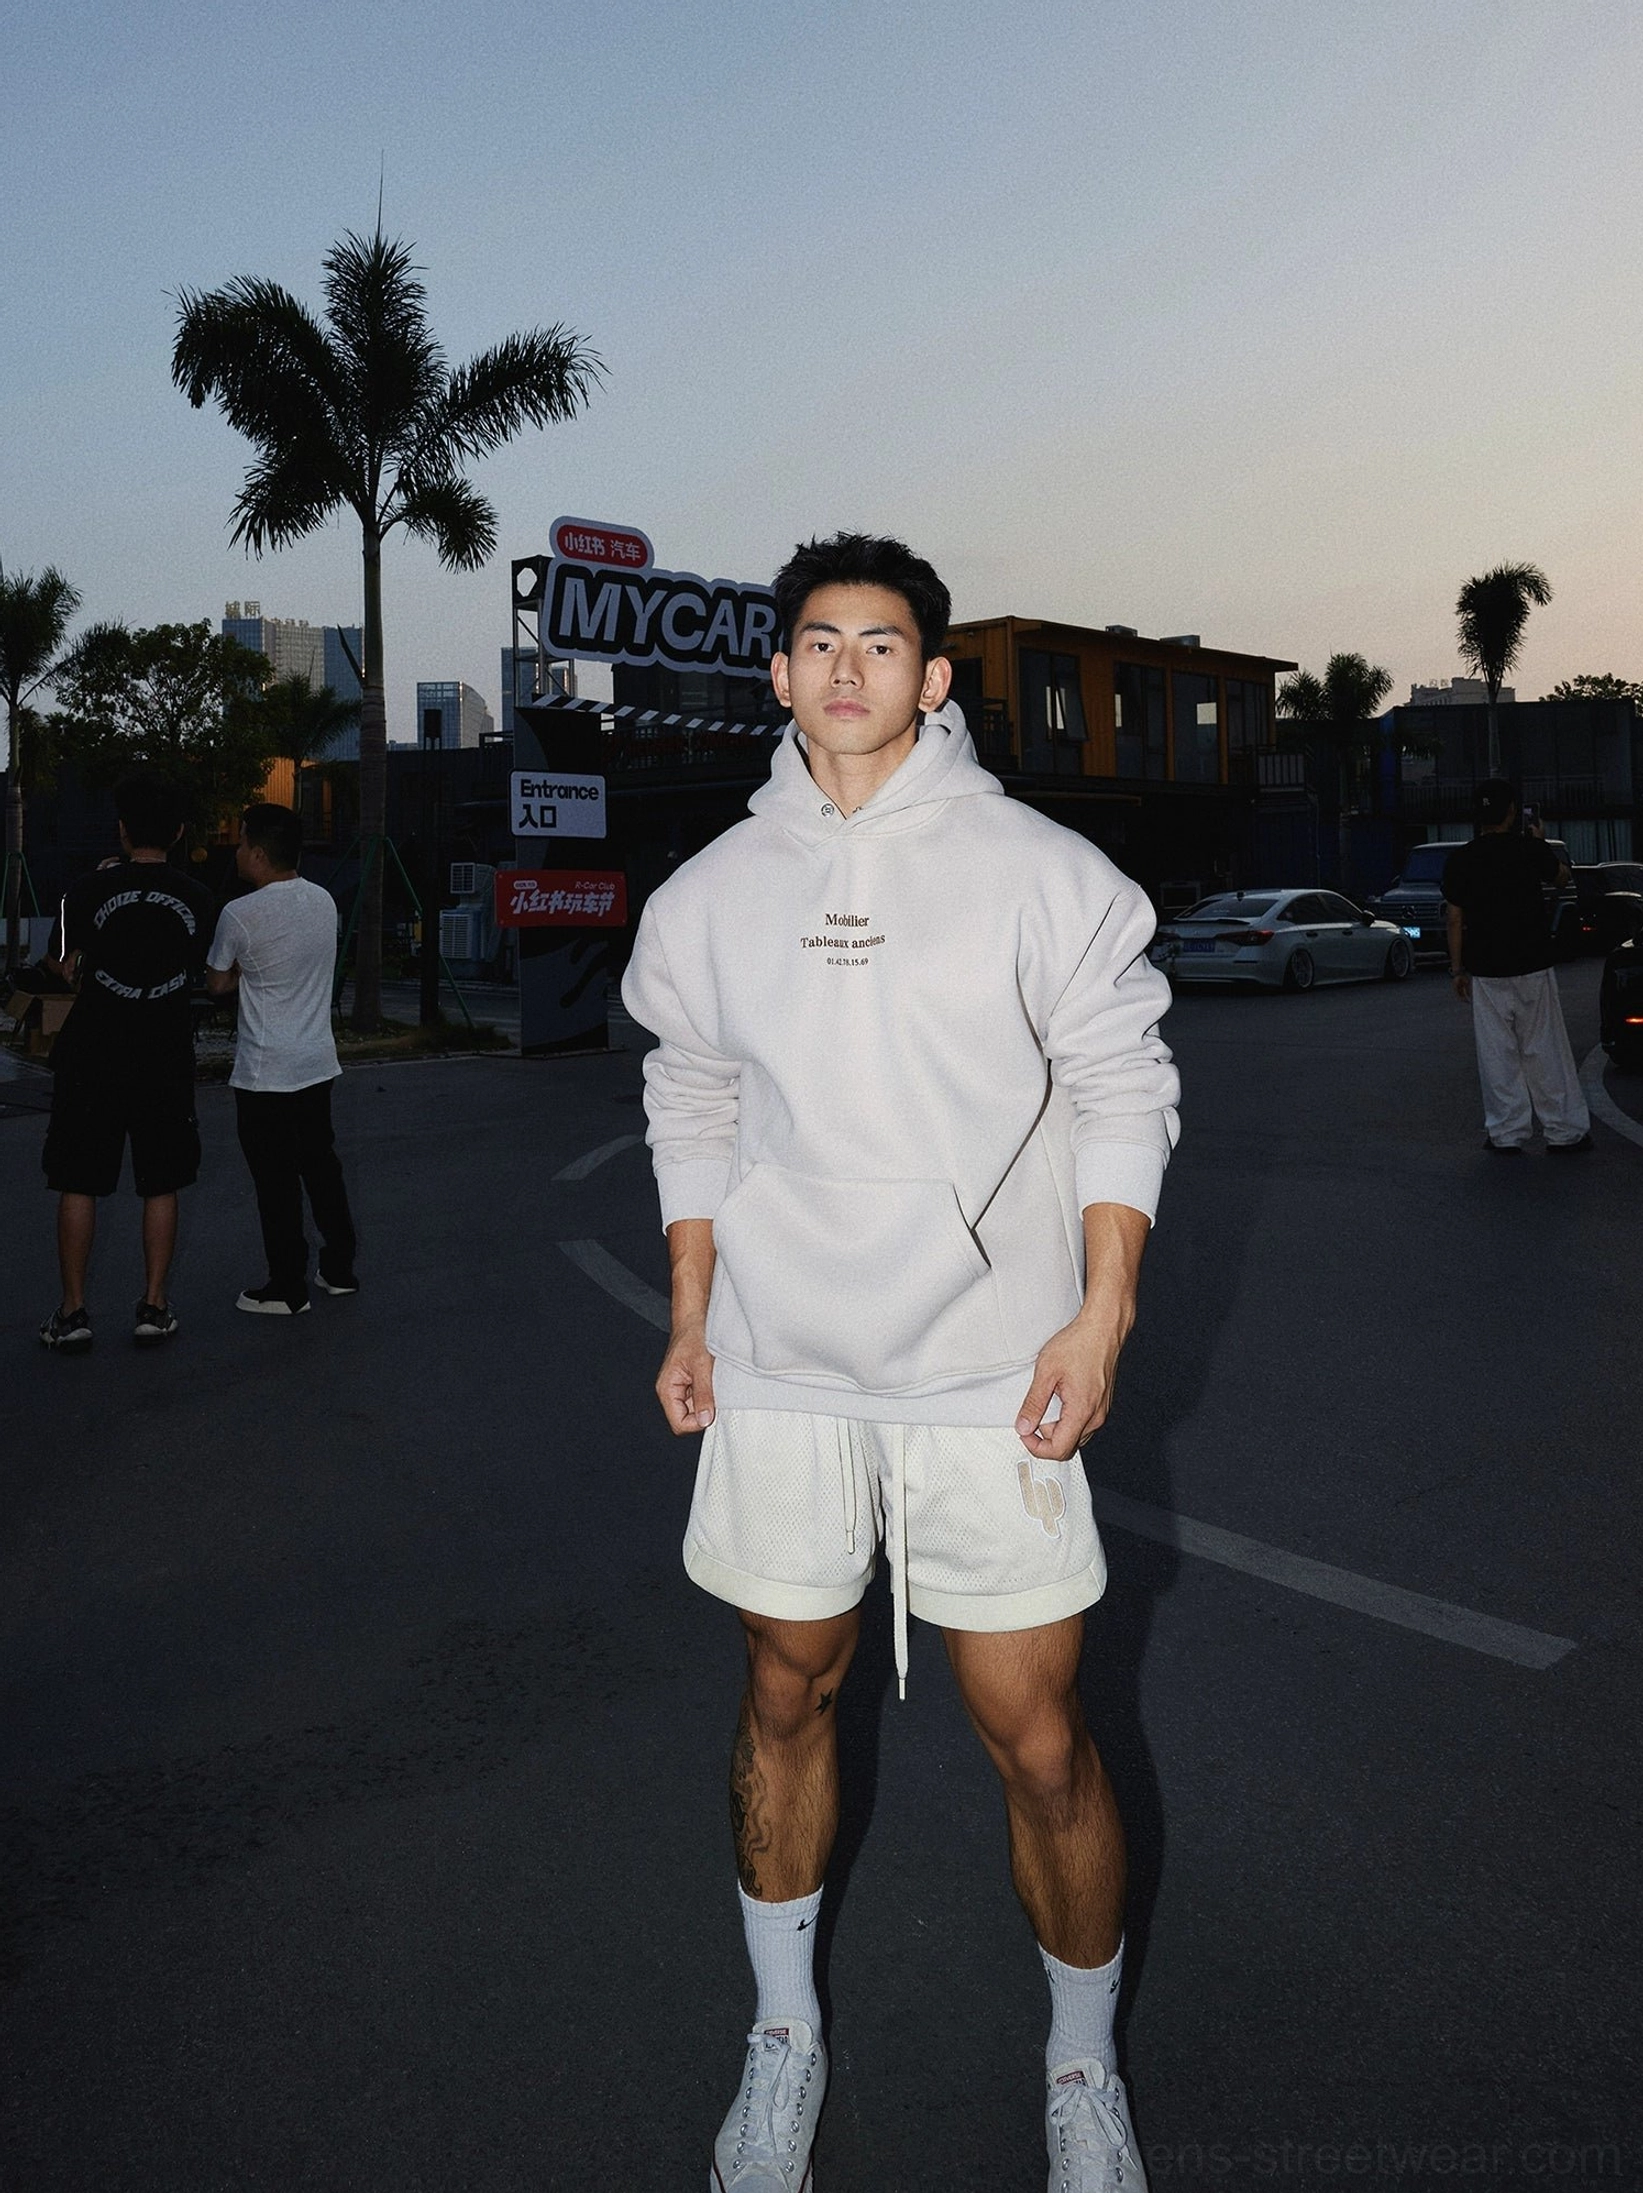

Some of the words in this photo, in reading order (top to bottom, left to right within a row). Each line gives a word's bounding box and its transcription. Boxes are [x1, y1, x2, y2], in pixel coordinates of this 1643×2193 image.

[564, 531, 606, 557] 小红书
[610, 539, 641, 561] 汽车
[558, 576, 784, 660] MYCAR
[520, 779, 599, 801] Entrance
[518, 804, 557, 829] 入口
[598, 881, 616, 891] Club
[93, 890, 142, 931] CHOIZE
[510, 888, 616, 918] 小红书玩车节
[825, 913, 870, 927] Mobilier
[800, 935, 850, 949] Tableaux
[851, 934, 886, 949] anciens
[94, 969, 144, 1000] EXTRA
[147, 967, 188, 1000] CASH
